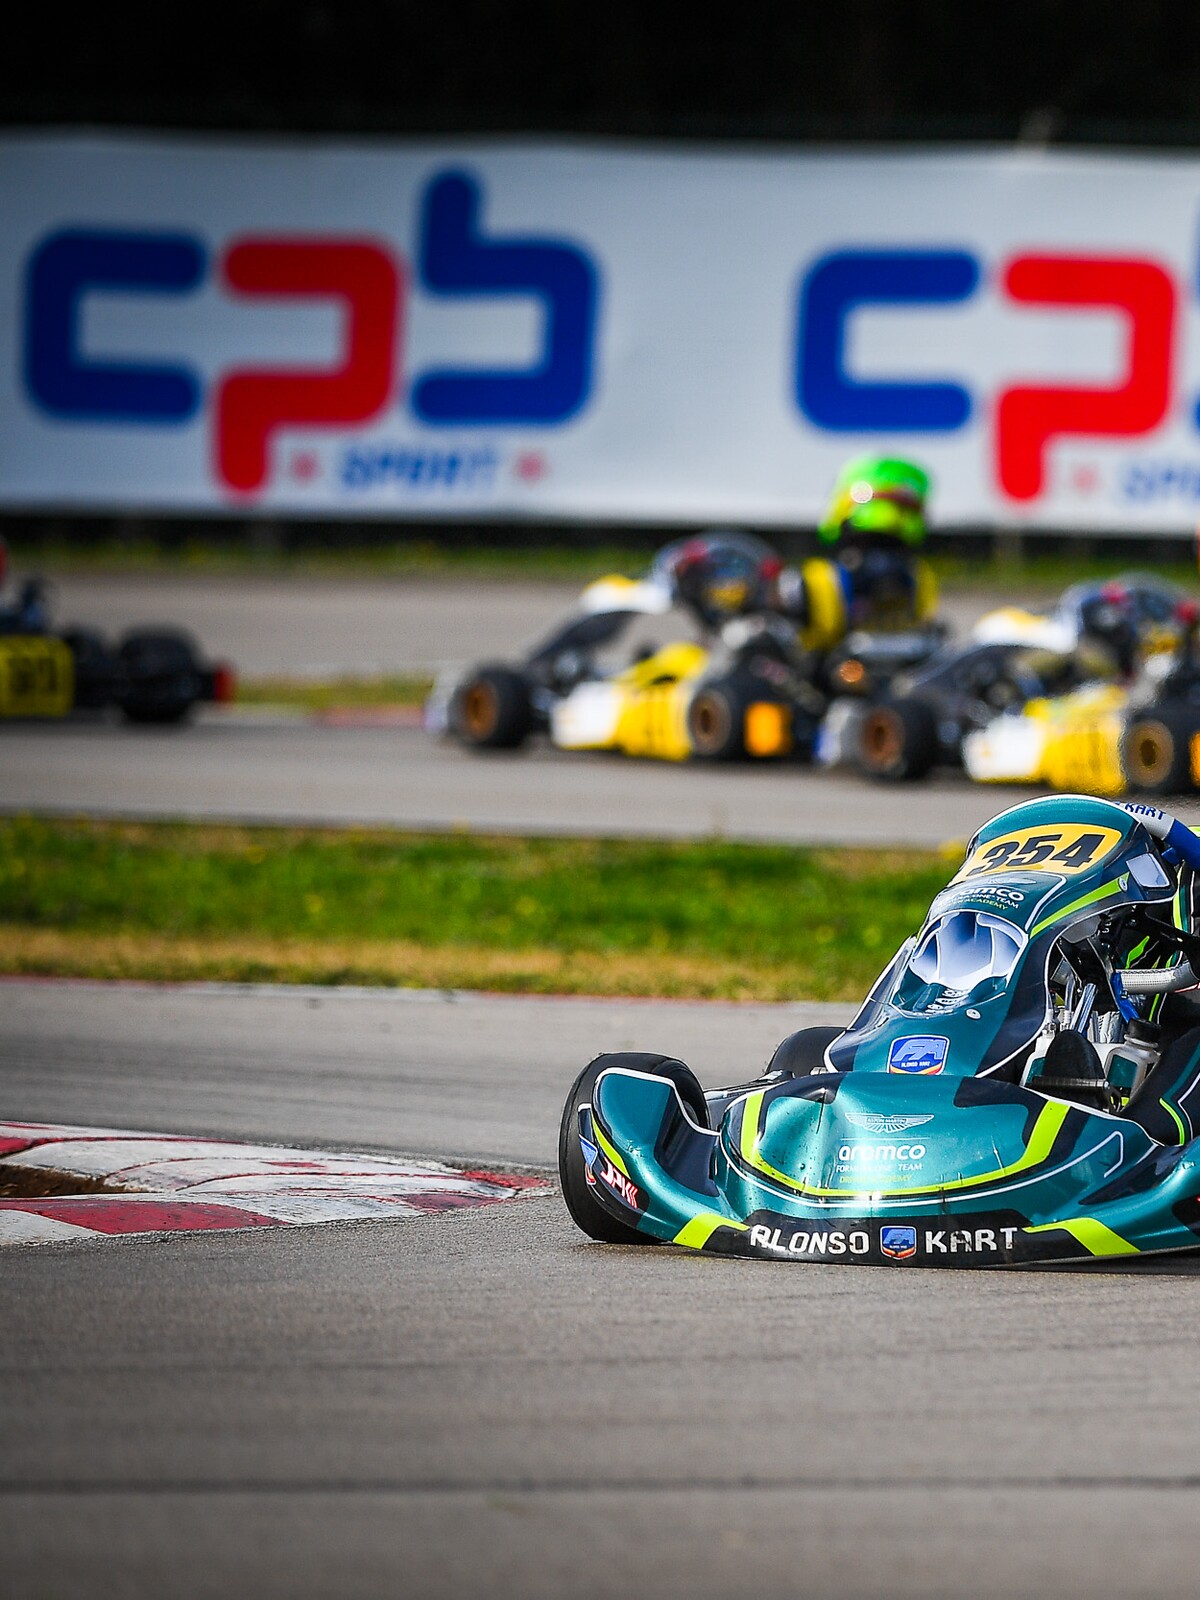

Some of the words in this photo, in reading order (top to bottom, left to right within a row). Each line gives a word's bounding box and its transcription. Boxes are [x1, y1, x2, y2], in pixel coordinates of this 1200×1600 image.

[24, 169, 598, 496] cpb
[1124, 802, 1167, 821] KART
[966, 834, 1106, 877] 354
[996, 896, 1019, 909] TEAM
[839, 1144, 926, 1161] aramco
[898, 1163, 923, 1172] TEAM
[750, 1224, 870, 1254] ALONSO
[925, 1227, 1018, 1254] KART
